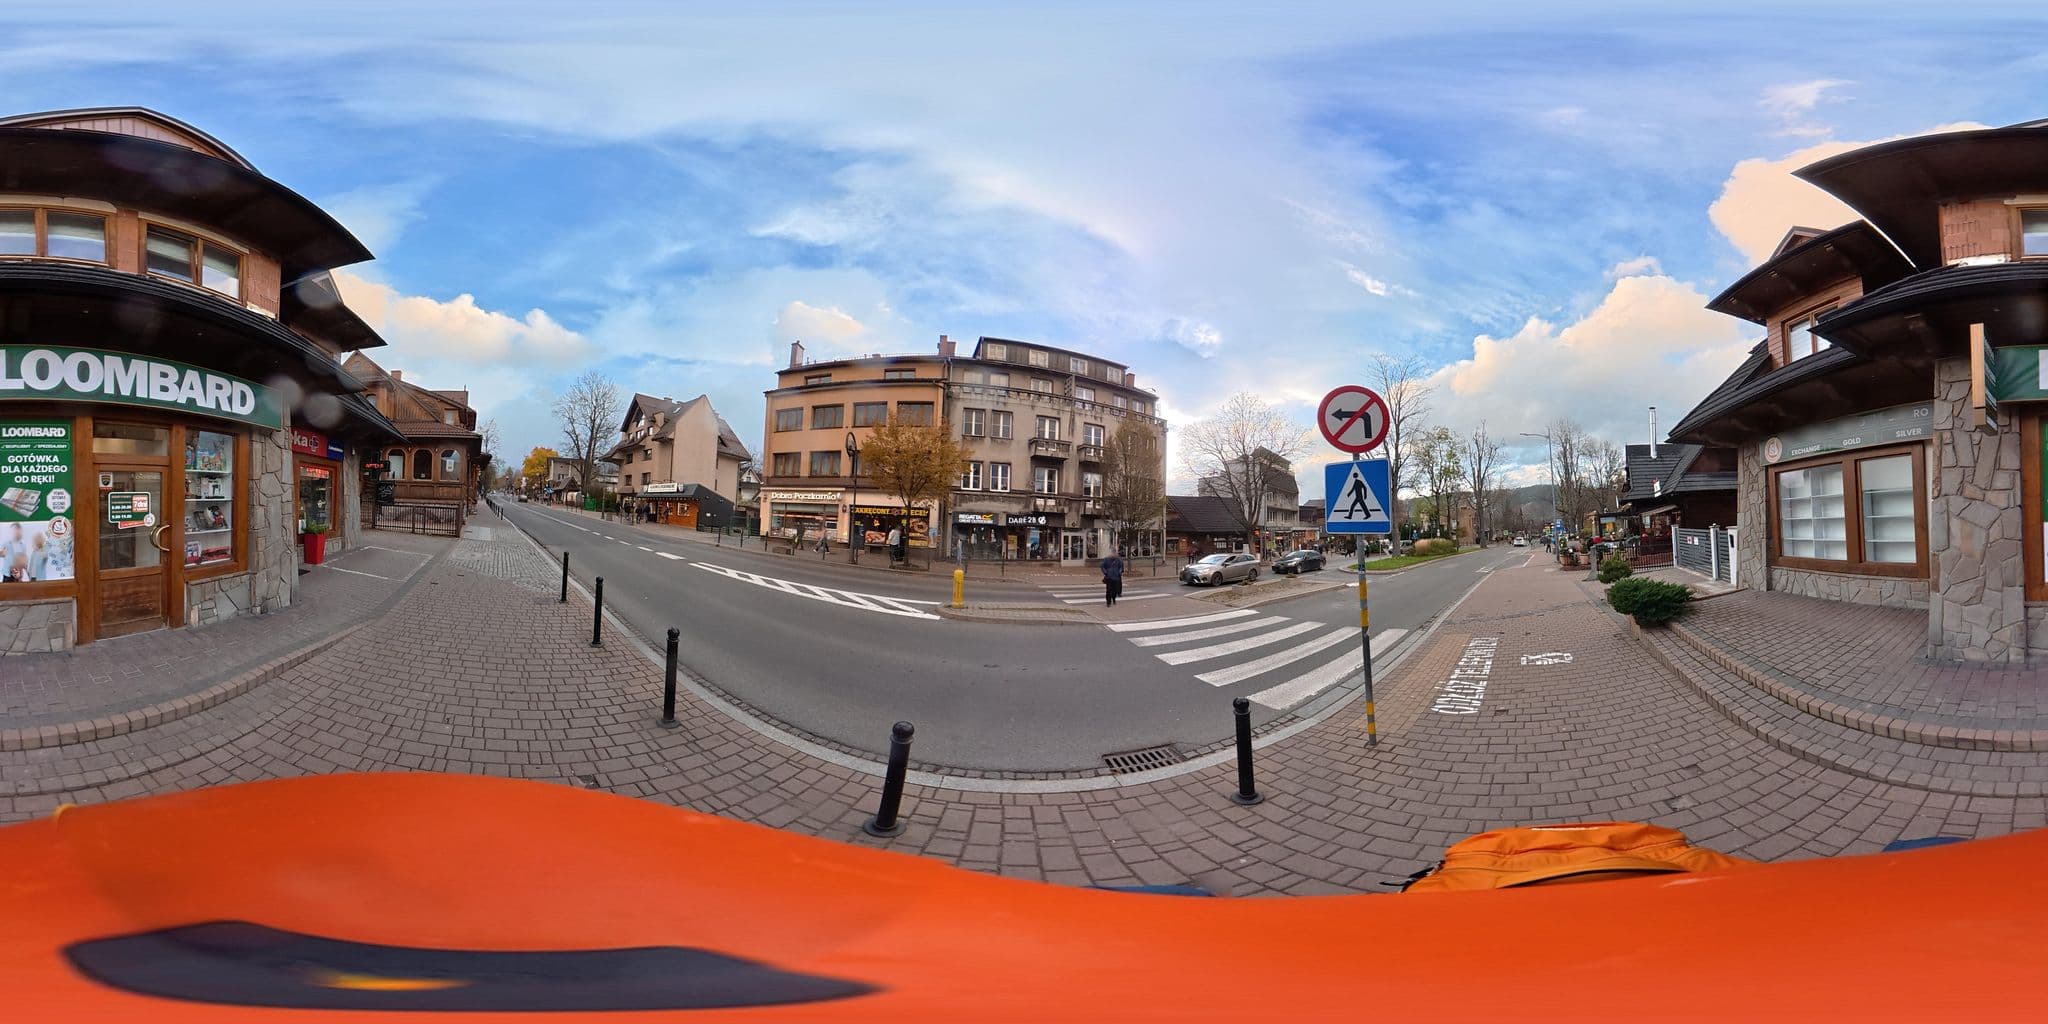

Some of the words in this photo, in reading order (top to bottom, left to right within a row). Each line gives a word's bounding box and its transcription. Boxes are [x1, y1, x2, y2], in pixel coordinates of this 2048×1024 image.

[1913, 408, 1929, 418] RO
[2, 427, 66, 437] LOOMBARD
[1791, 444, 1821, 456] EXCHANGE
[1842, 437, 1861, 446] GOLD
[1895, 427, 1922, 438] SILVER
[7, 453, 59, 463] GOTÓWKA
[22, 464, 68, 473] KAŻDEGO
[31, 475, 55, 485] RĘKI!
[1430, 680, 1487, 714] ODŁÓŻ
